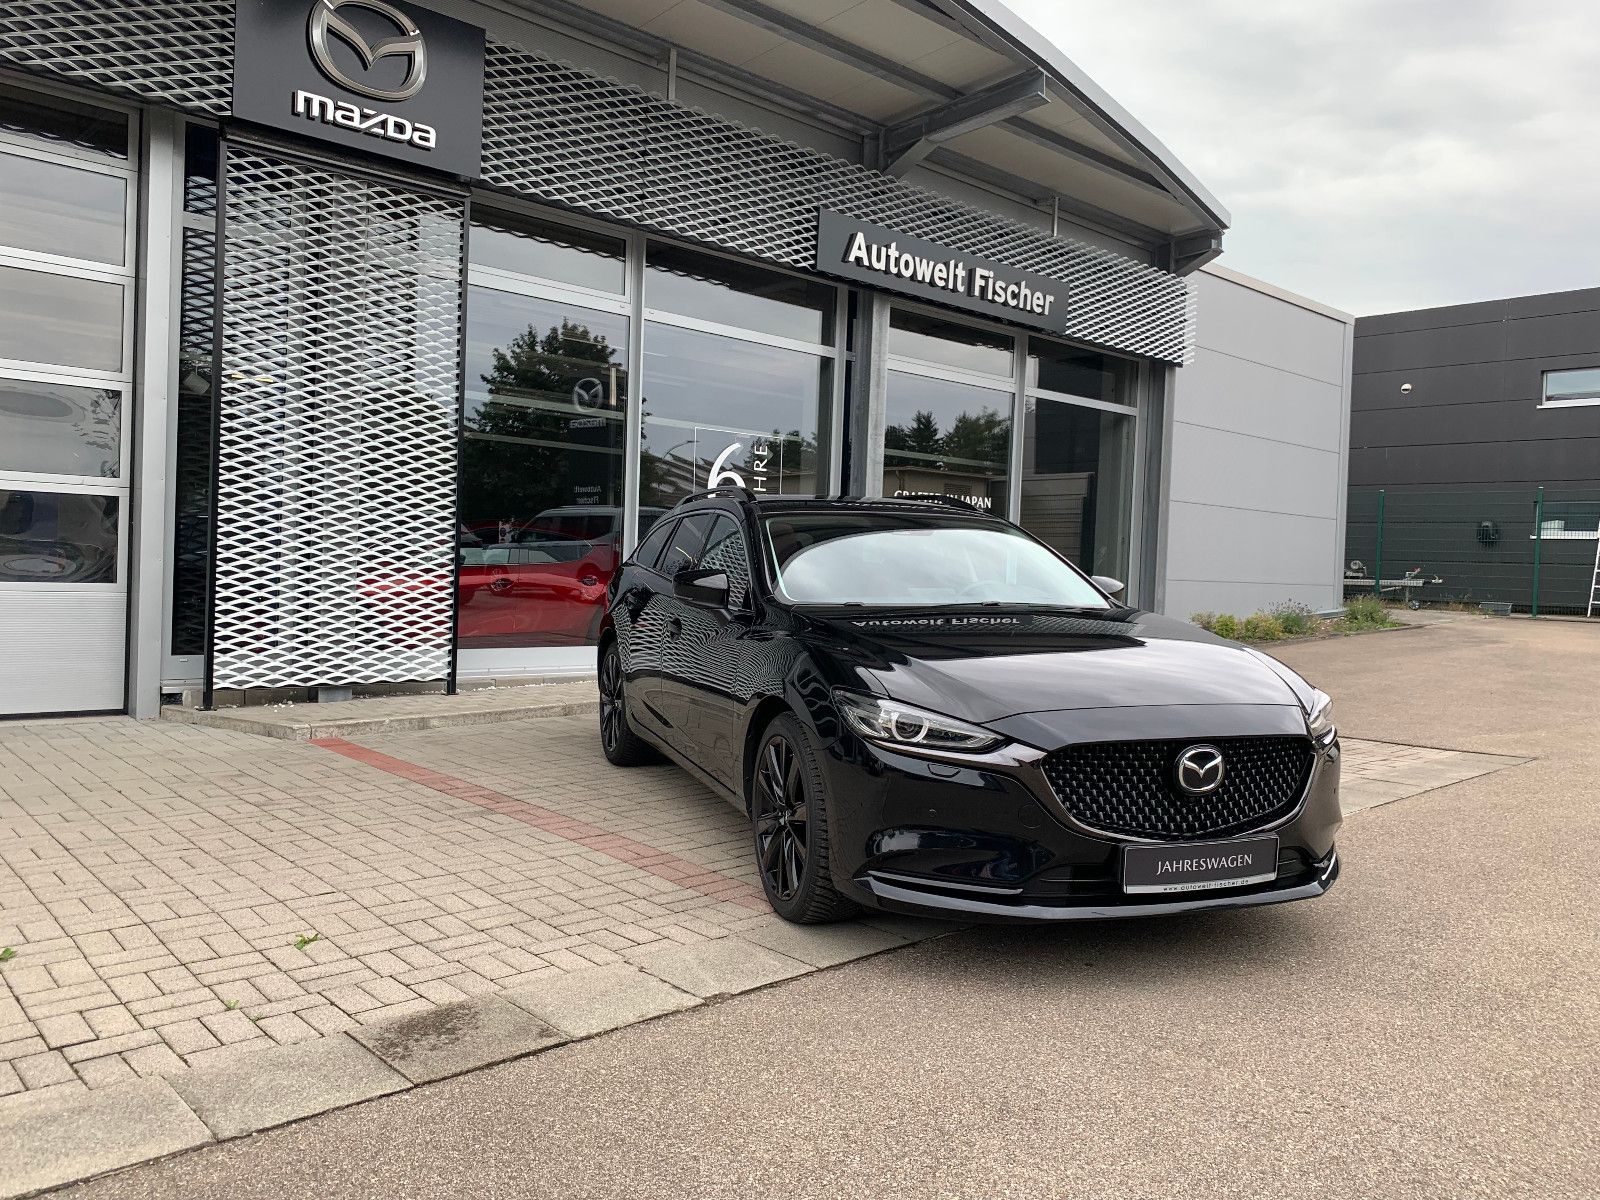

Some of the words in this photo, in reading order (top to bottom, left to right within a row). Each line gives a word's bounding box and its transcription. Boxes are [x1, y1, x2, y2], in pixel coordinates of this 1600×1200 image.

[848, 232, 966, 293] Autowelt
[973, 267, 1055, 316] Fischer
[1156, 853, 1253, 876] JAHRESWAGEN
